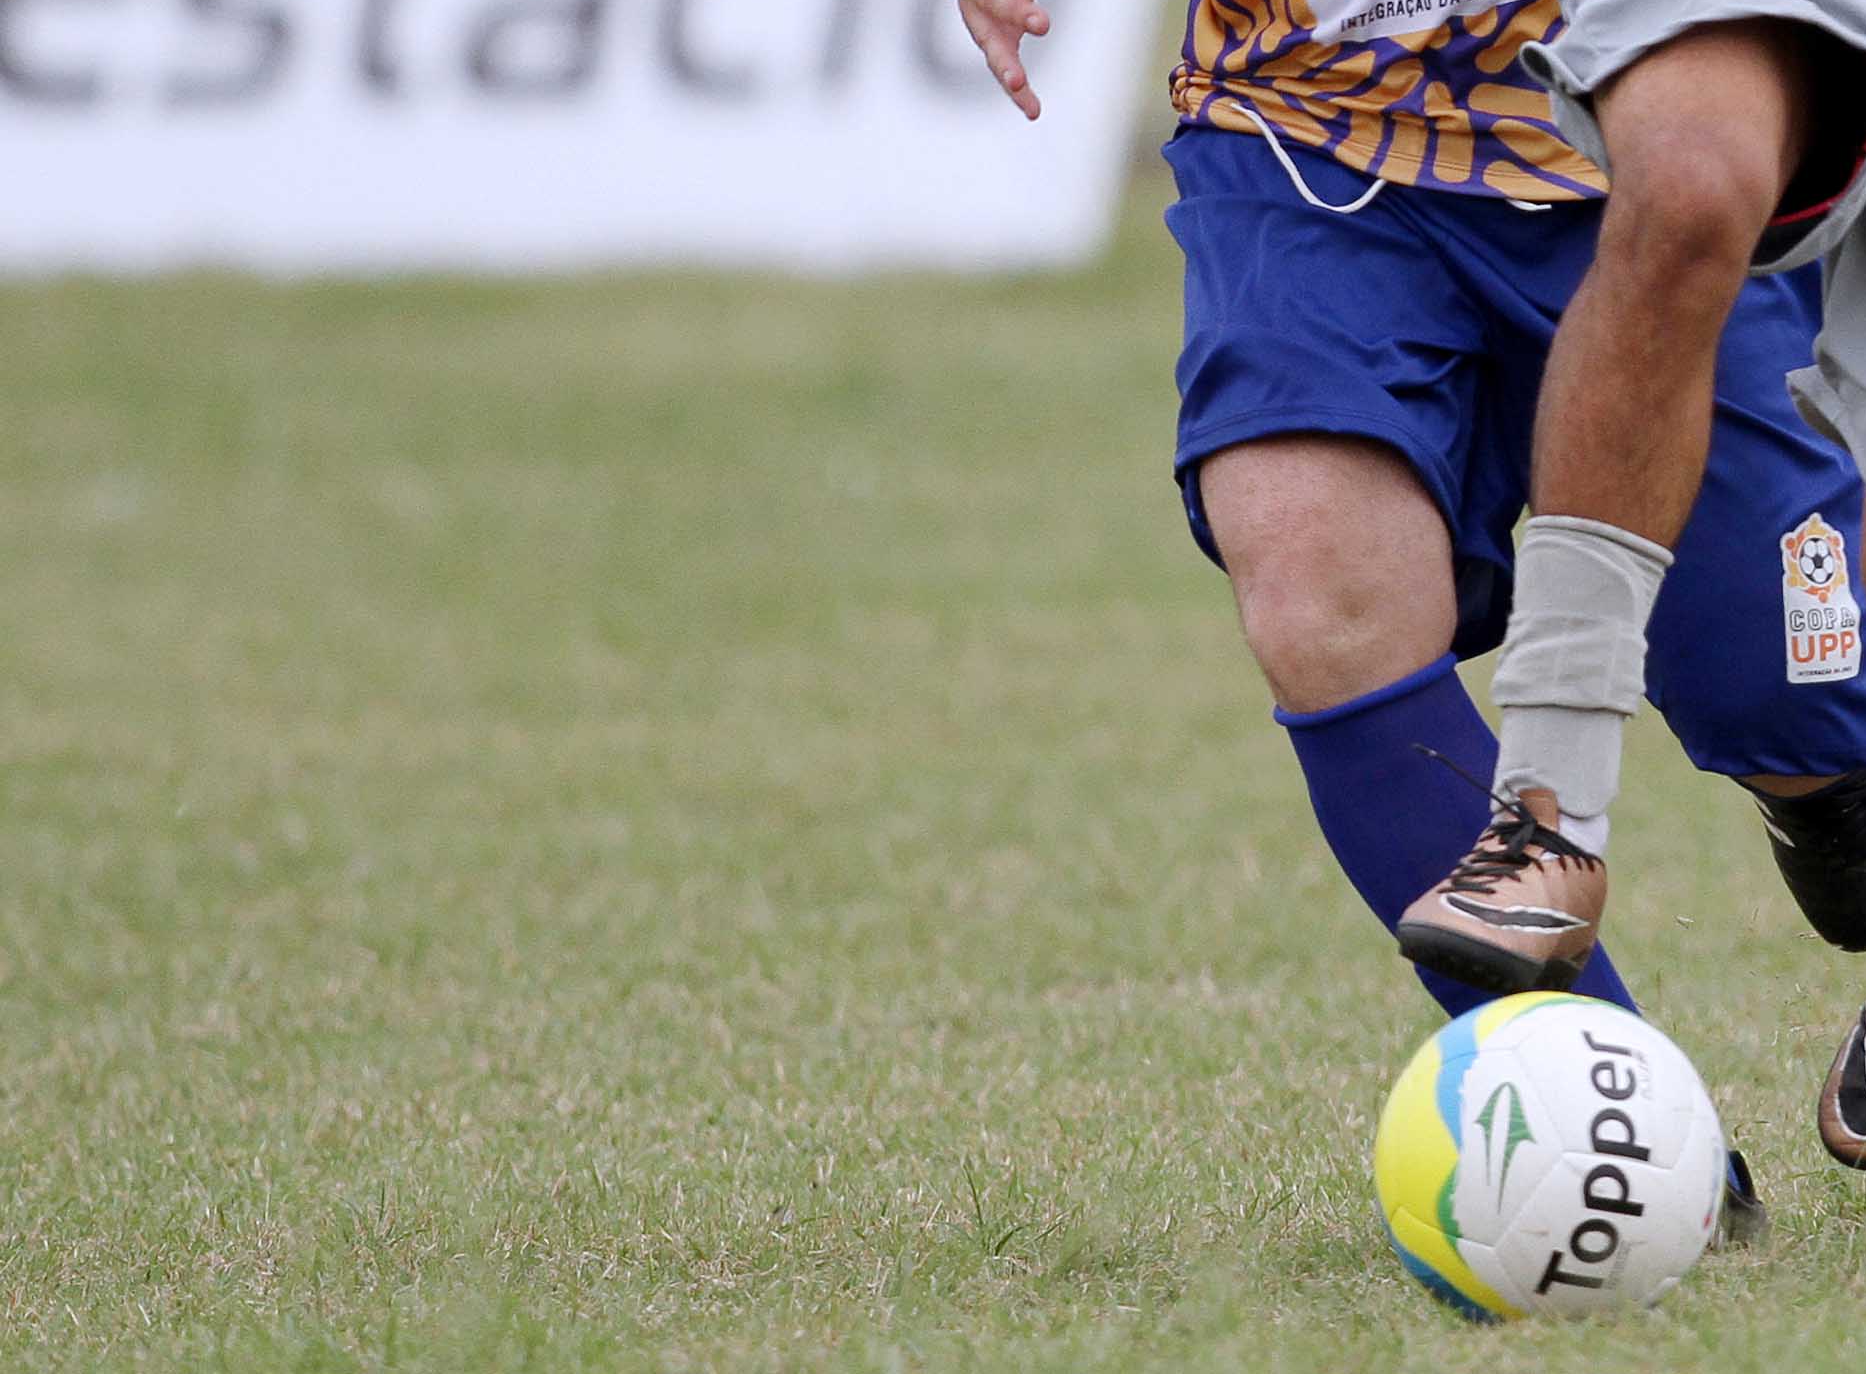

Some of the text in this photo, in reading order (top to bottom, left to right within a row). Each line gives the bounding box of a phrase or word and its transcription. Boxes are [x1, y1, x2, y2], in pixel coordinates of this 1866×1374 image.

[1789, 607, 1856, 632] COPA
[1791, 630, 1857, 663] UPP
[1535, 1029, 1651, 1296] Topper
